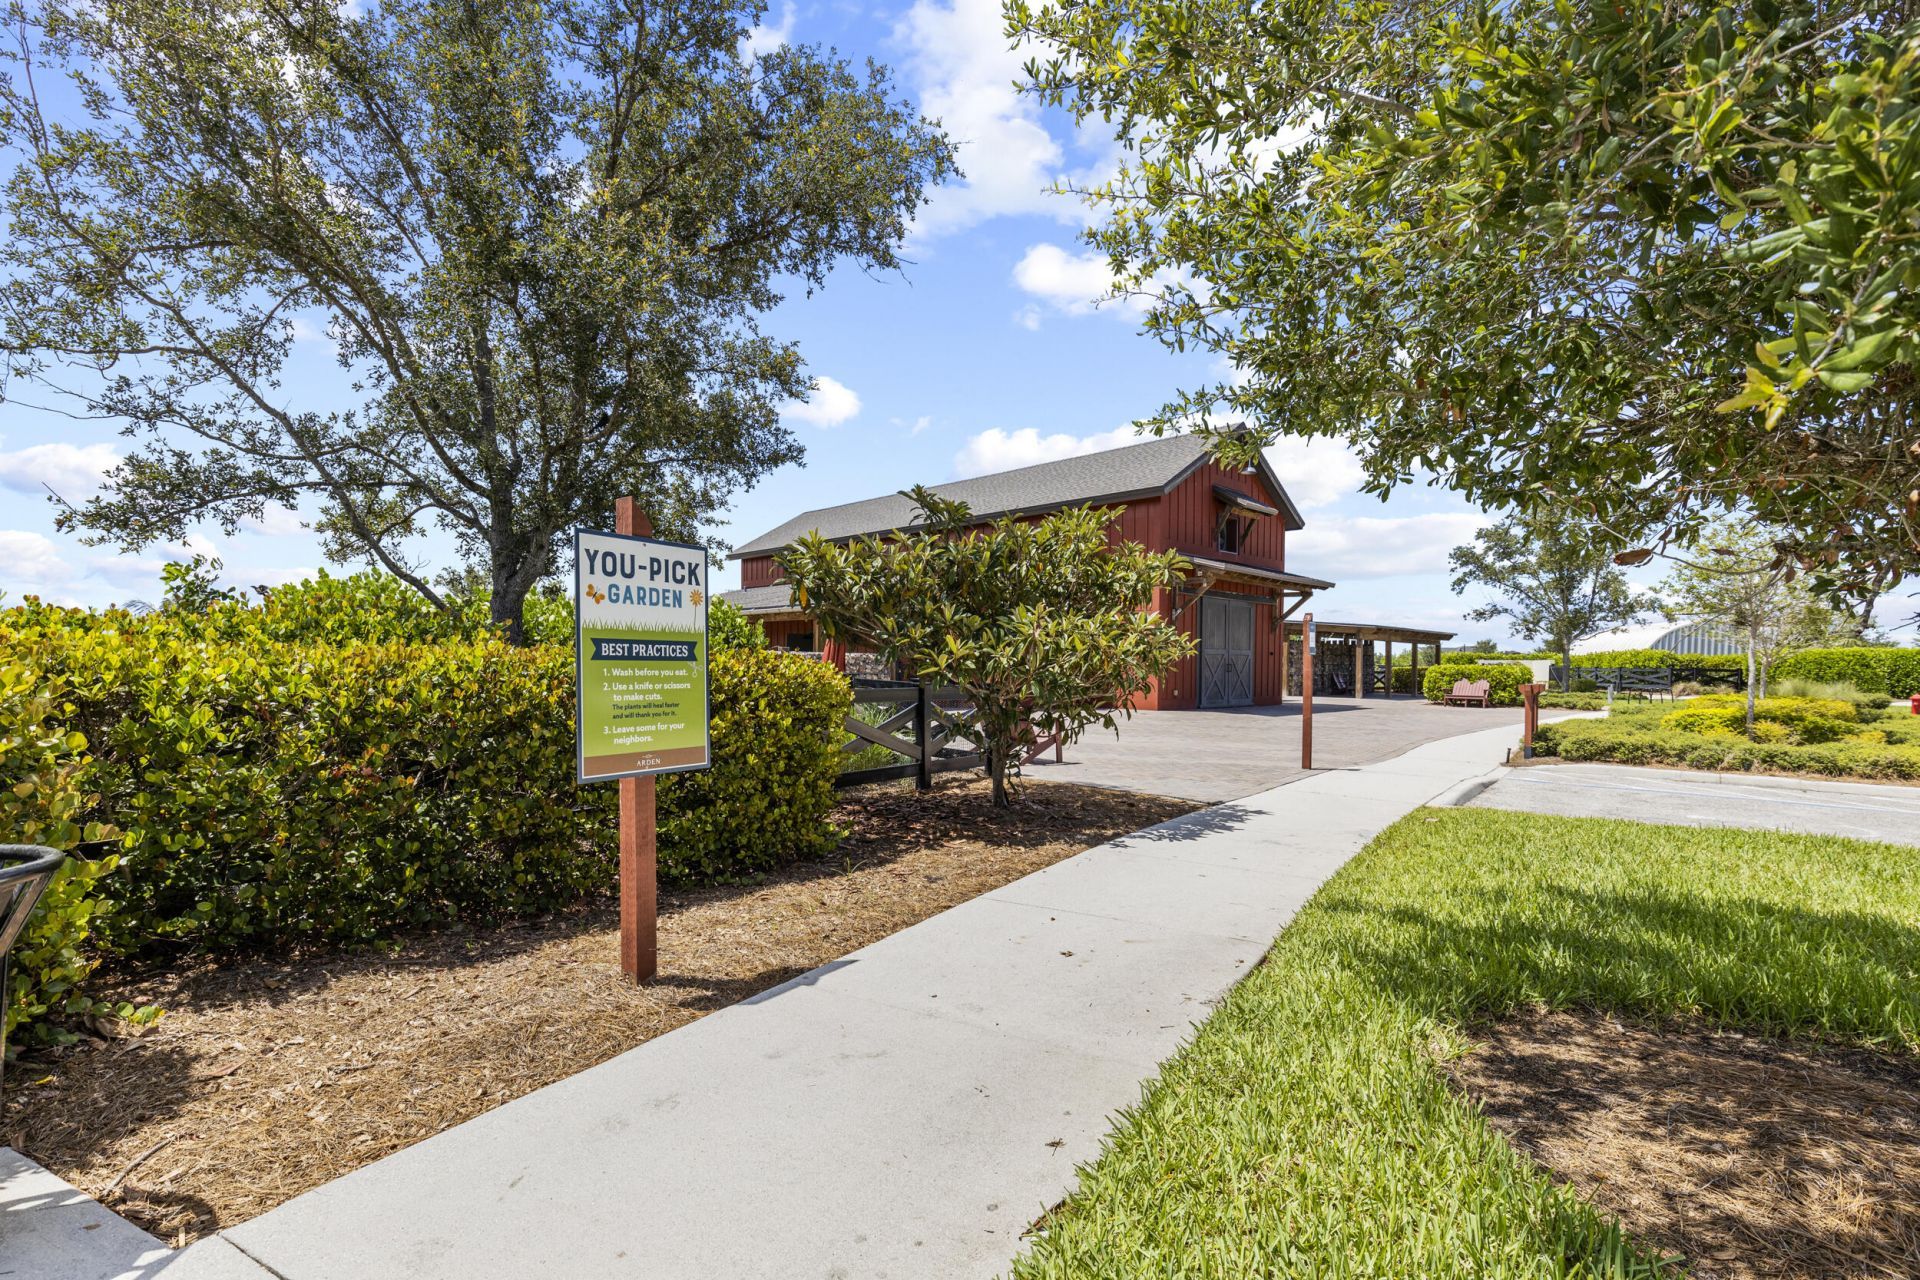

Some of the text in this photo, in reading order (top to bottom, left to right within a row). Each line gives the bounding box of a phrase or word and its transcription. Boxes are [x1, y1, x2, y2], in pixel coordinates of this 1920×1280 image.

[584, 548, 700, 586] YOU-PICK
[607, 583, 682, 609] GARDEN
[601, 643, 689, 657] BEST PRACTICES
[603, 668, 610, 677] 1.
[612, 668, 634, 676] Wash
[635, 668, 659, 676] before
[660, 670, 673, 678] you
[603, 682, 611, 691] 2.
[612, 682, 627, 690] Use
[634, 681, 653, 690] knife
[663, 681, 691, 689] scissors
[613, 692, 663, 701] to make cuts.
[624, 702, 642, 711] plants
[652, 711, 662, 719] you
[603, 722, 685, 734] 3. Leave some for your
[613, 735, 653, 745] neighbors.
[636, 758, 661, 767] ARDEN
